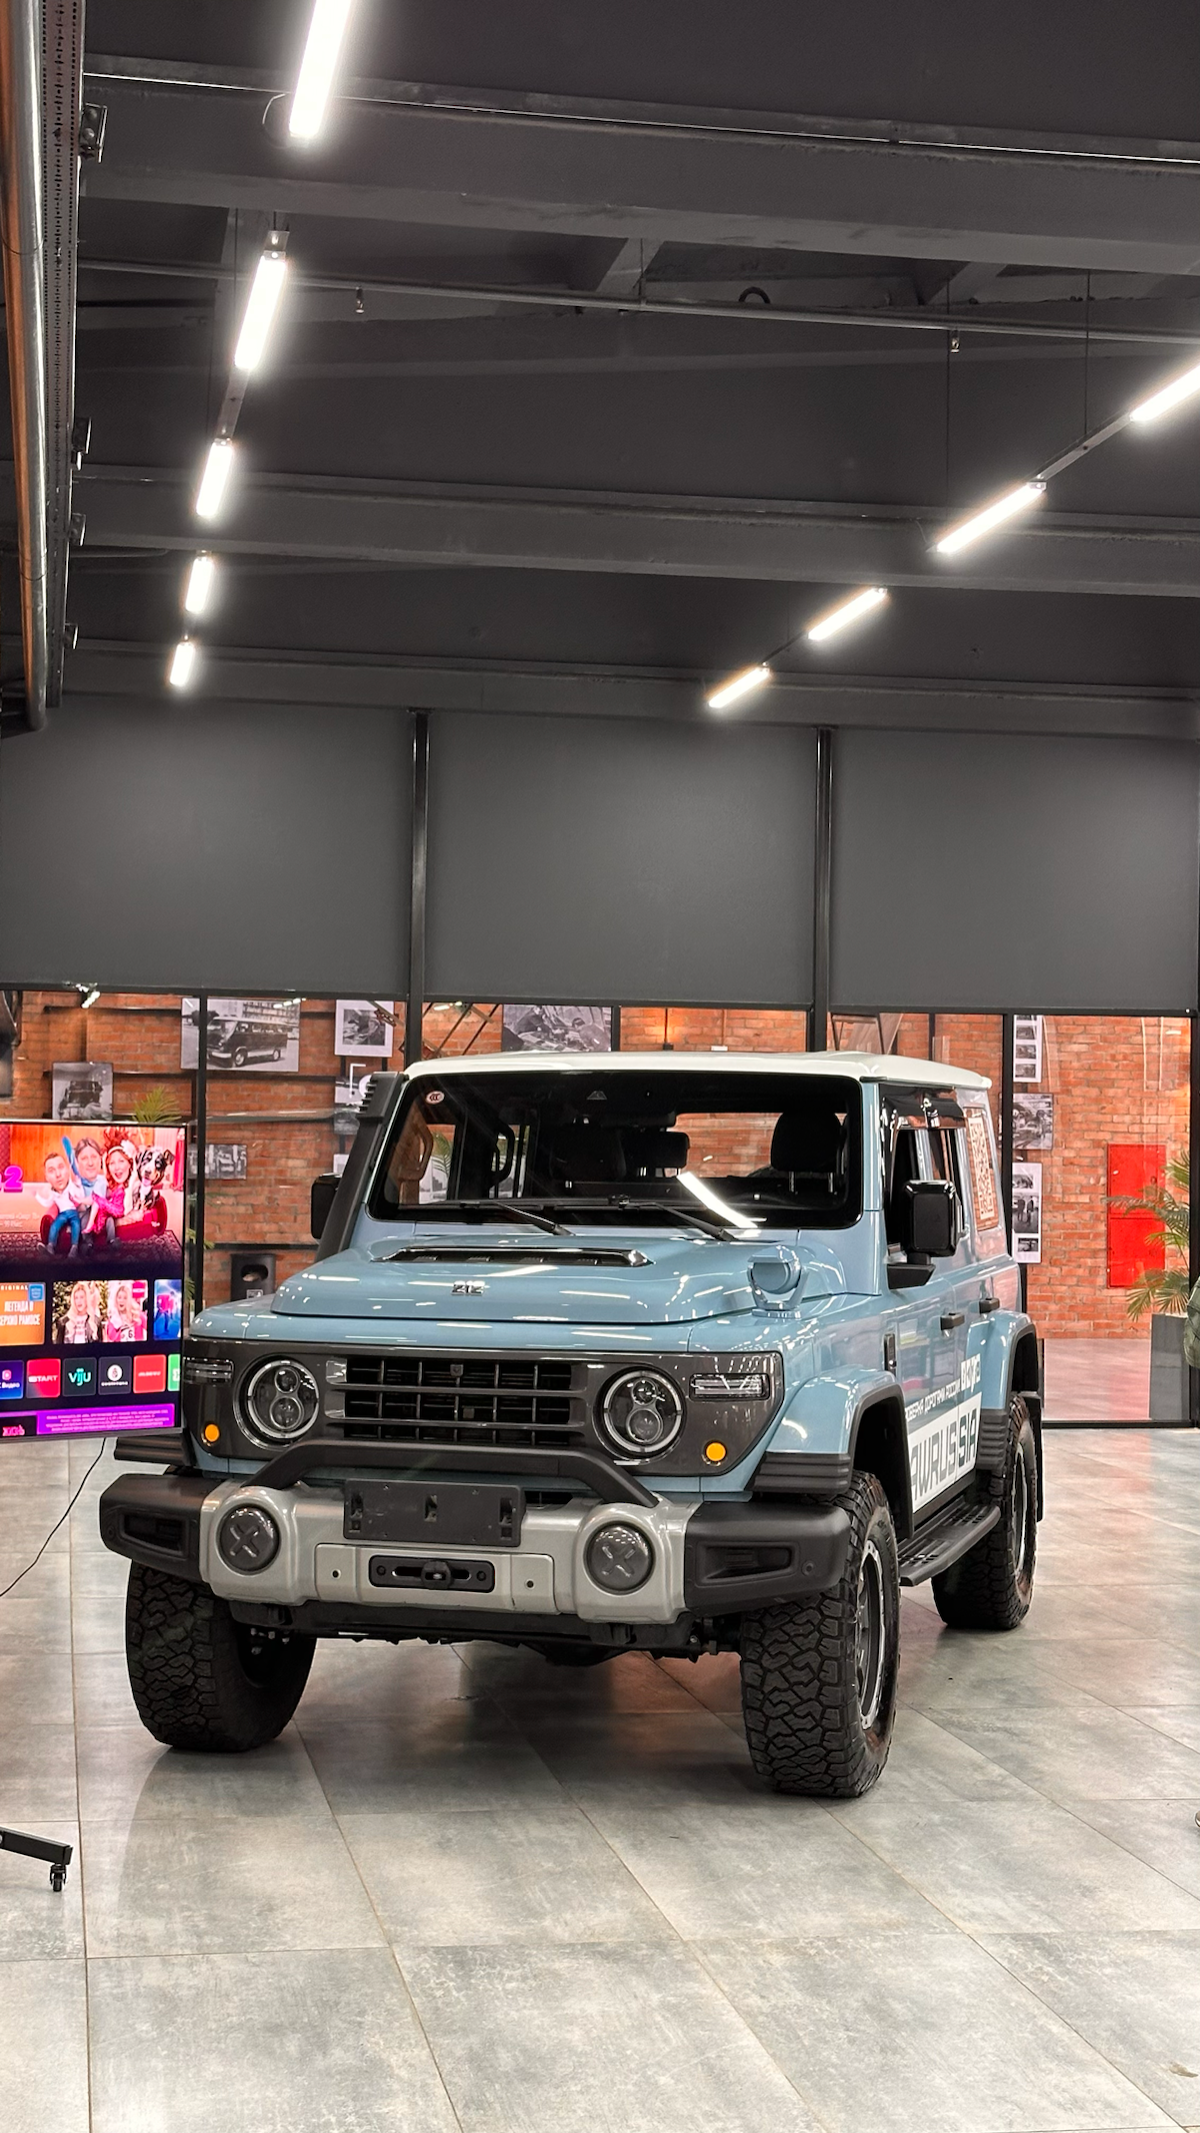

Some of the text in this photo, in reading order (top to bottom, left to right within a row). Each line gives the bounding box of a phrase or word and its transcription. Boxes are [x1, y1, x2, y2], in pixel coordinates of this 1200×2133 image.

[3, 1165, 23, 1193] 2
[4, 1300, 28, 1313] ЛЕГЕНДА
[19, 1313, 41, 1326] РАМОСЕ
[946, 1377, 961, 1399] РОССИИ
[910, 1408, 977, 1500] AWRUSSIA
